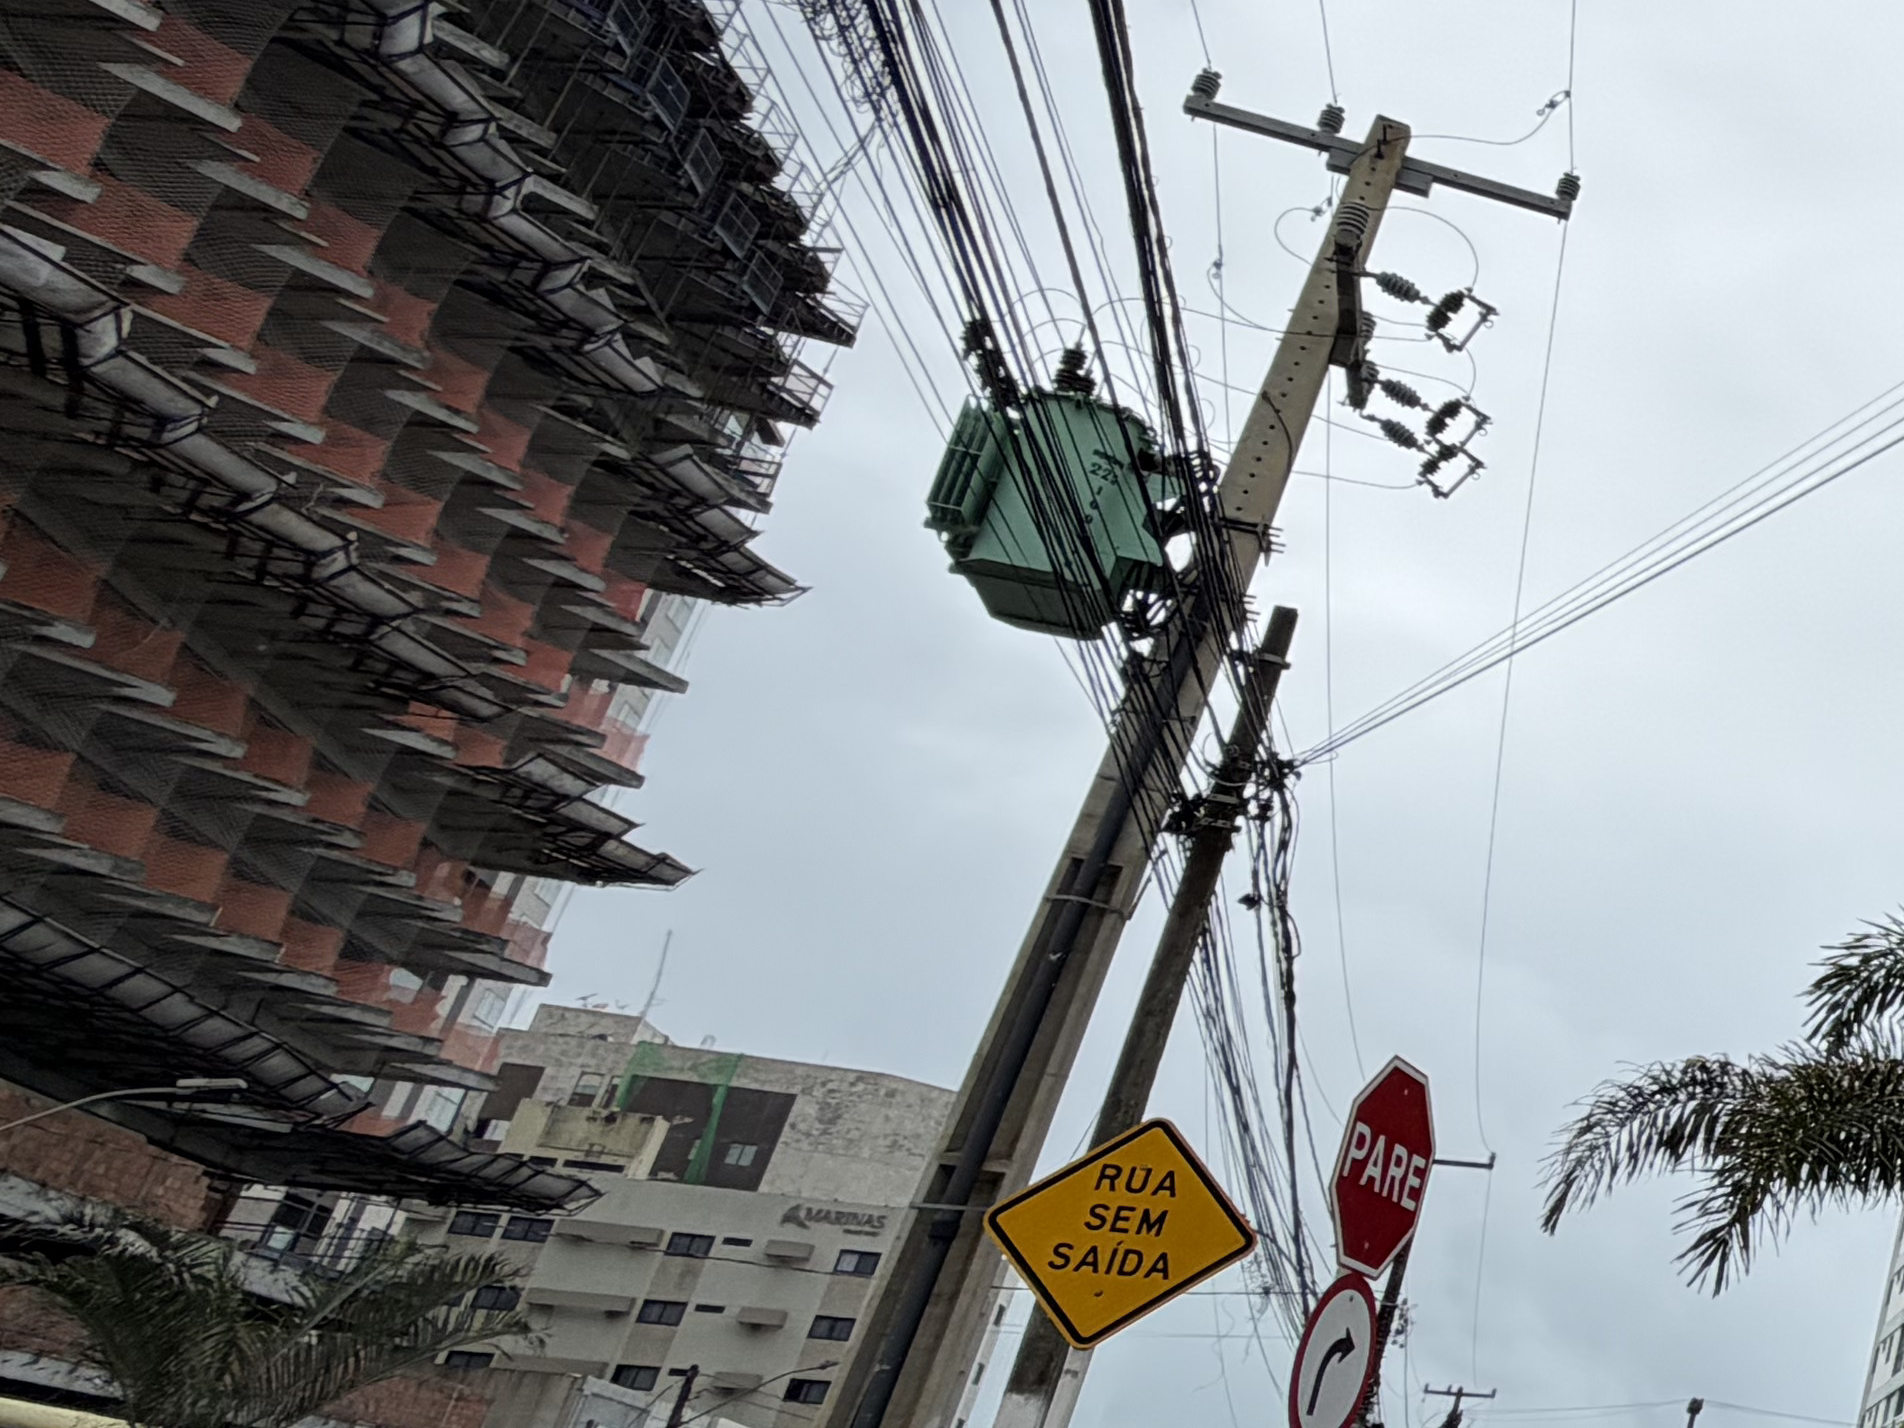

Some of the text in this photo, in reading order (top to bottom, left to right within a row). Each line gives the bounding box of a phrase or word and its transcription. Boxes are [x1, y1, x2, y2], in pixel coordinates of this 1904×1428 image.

[1094, 1163, 1177, 1198] RUA
[1342, 1121, 1426, 1212] PARE
[804, 1206, 888, 1229] MARINAS
[1083, 1203, 1169, 1238] SEM
[1047, 1240, 1170, 1281] SAÍDA
